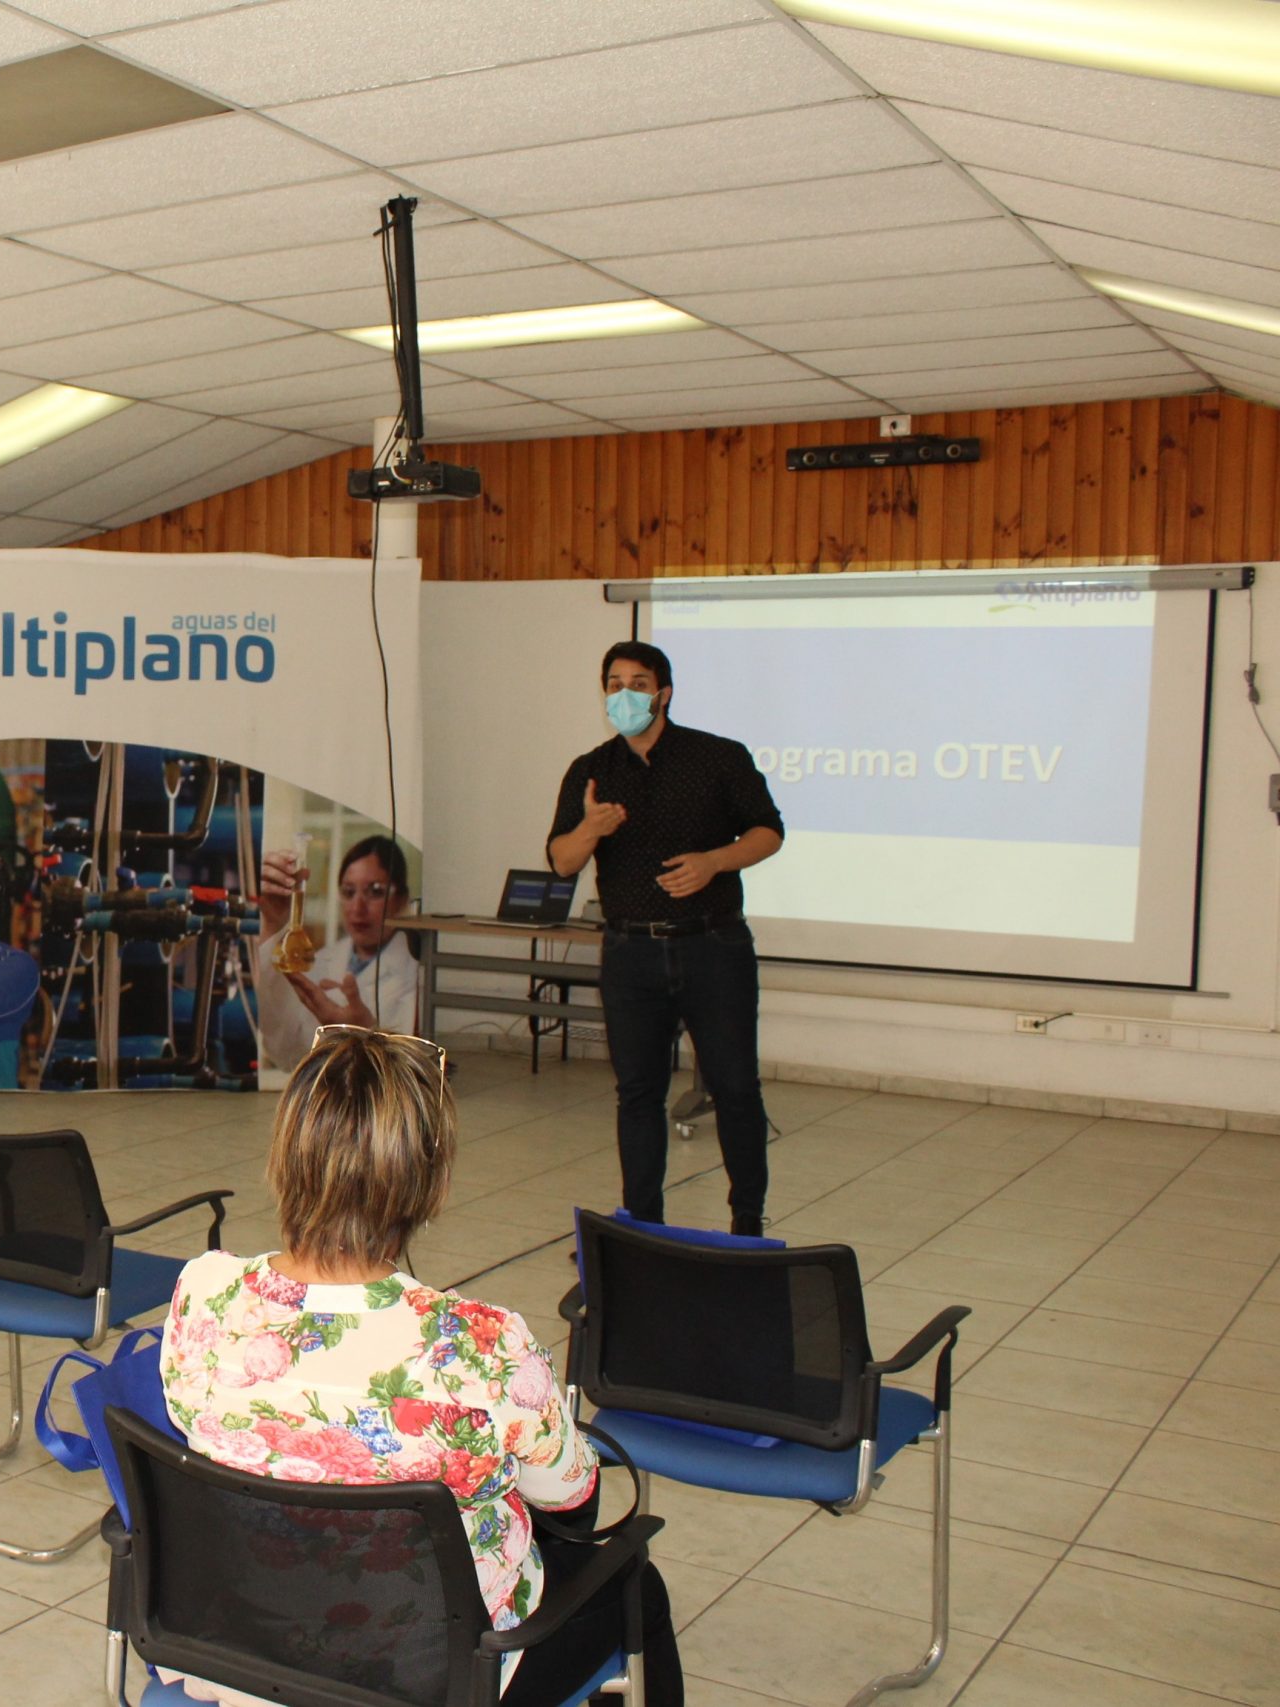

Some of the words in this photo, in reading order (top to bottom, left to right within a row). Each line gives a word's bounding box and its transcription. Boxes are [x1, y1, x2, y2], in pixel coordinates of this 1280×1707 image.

[171, 614, 238, 635] aguas
[243, 611, 276, 633] del
[933, 741, 1064, 784] OTEV
